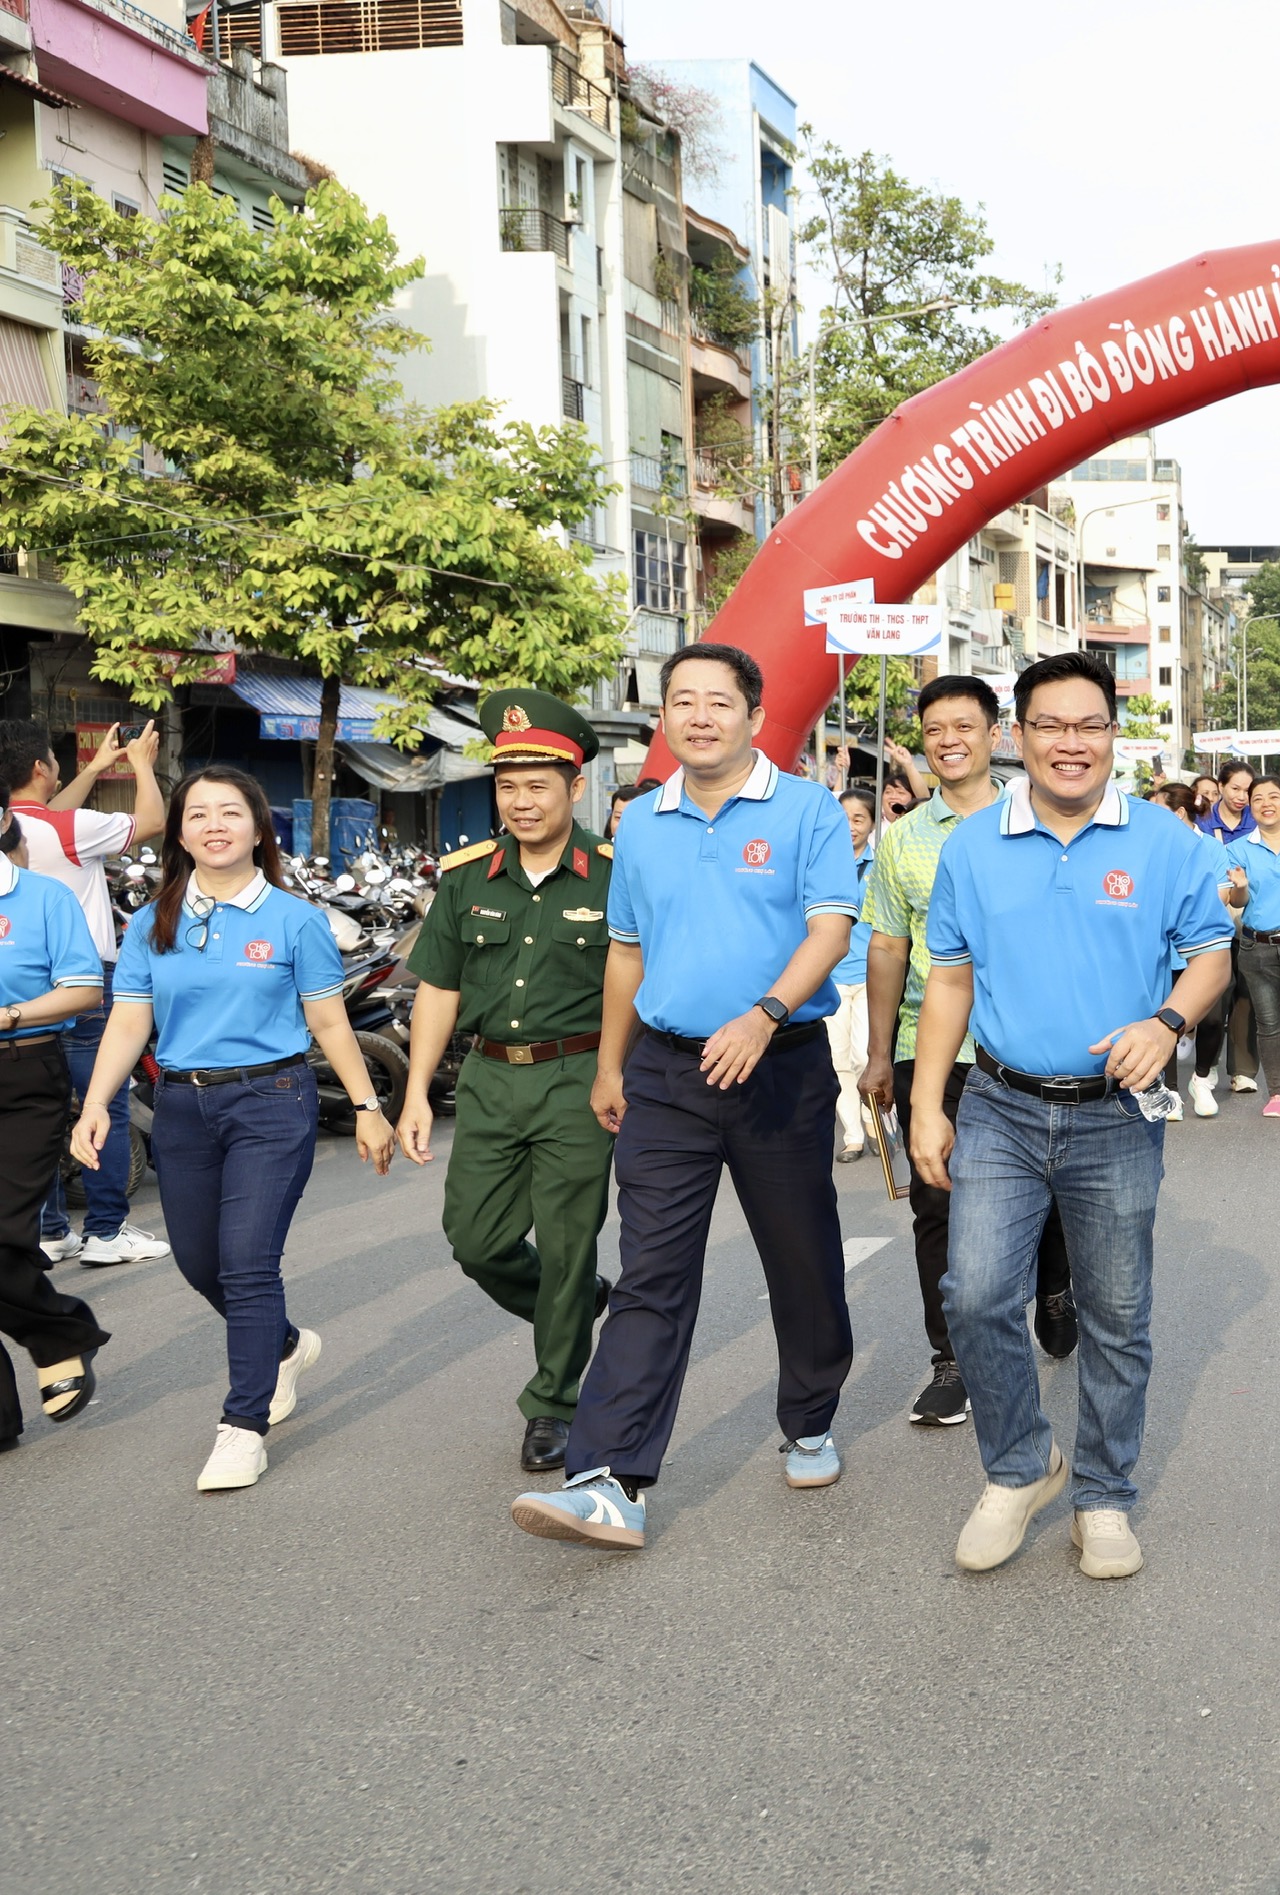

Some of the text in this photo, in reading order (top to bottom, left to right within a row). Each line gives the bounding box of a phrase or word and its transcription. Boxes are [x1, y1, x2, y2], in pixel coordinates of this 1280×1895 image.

[856, 443, 974, 559] CHƯƠNG
[950, 401, 1047, 476] TRÌNH
[1028, 370, 1076, 430] ĐI
[1101, 319, 1195, 394] ĐỒNG
[1189, 286, 1279, 362] HÀNH
[840, 611, 867, 624] TRƯỜNG
[887, 614, 905, 624] THCS
[912, 614, 929, 625] THPT
[867, 628, 901, 640] VĂN LANG
